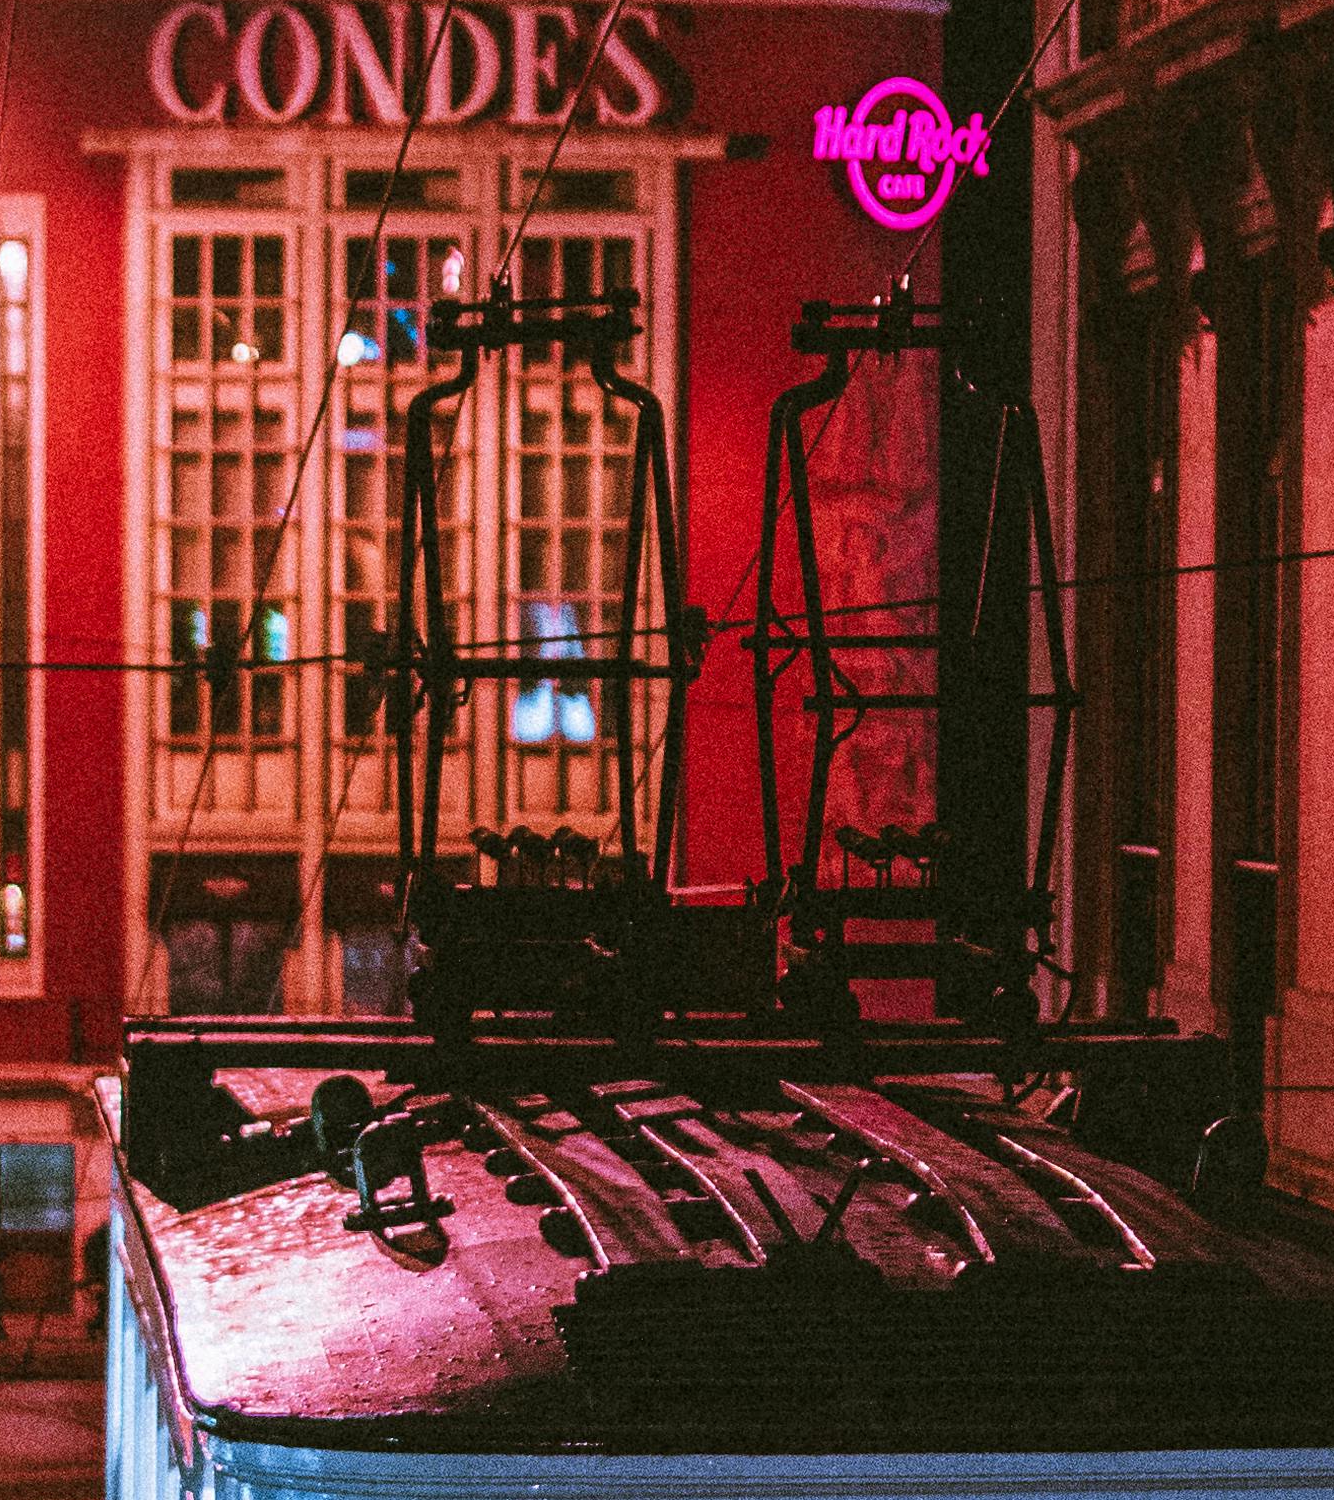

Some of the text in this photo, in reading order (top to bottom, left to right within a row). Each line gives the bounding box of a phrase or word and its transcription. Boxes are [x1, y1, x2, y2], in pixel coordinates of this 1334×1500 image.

[149, 1, 661, 126] CONDES
[813, 105, 992, 177] Hard Rock
